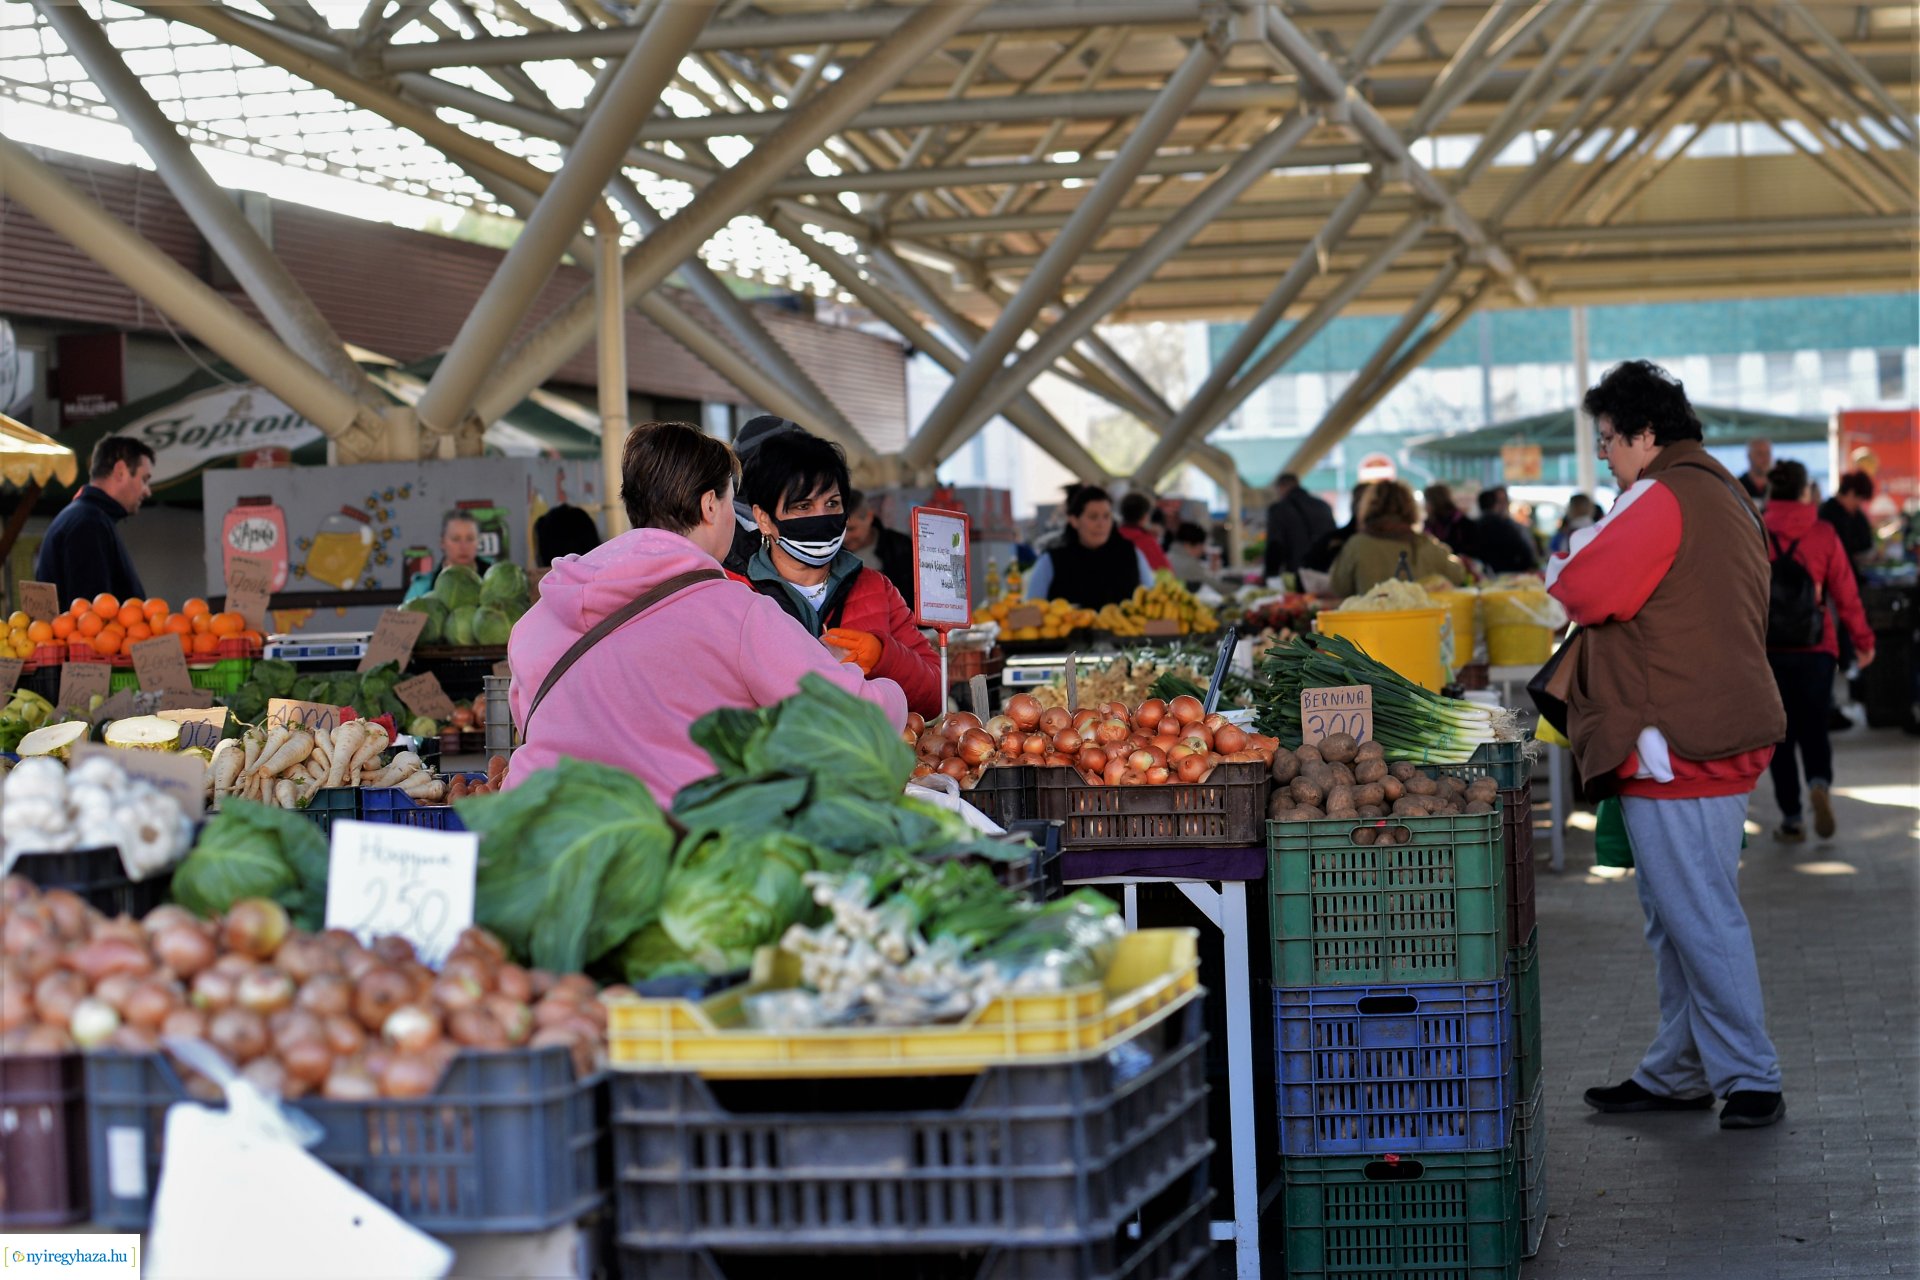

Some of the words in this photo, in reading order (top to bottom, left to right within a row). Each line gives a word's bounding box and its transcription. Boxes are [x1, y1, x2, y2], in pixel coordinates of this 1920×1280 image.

[142, 411, 312, 449] Sopron
[1308, 712, 1365, 746] 300
[353, 875, 451, 946] 250
